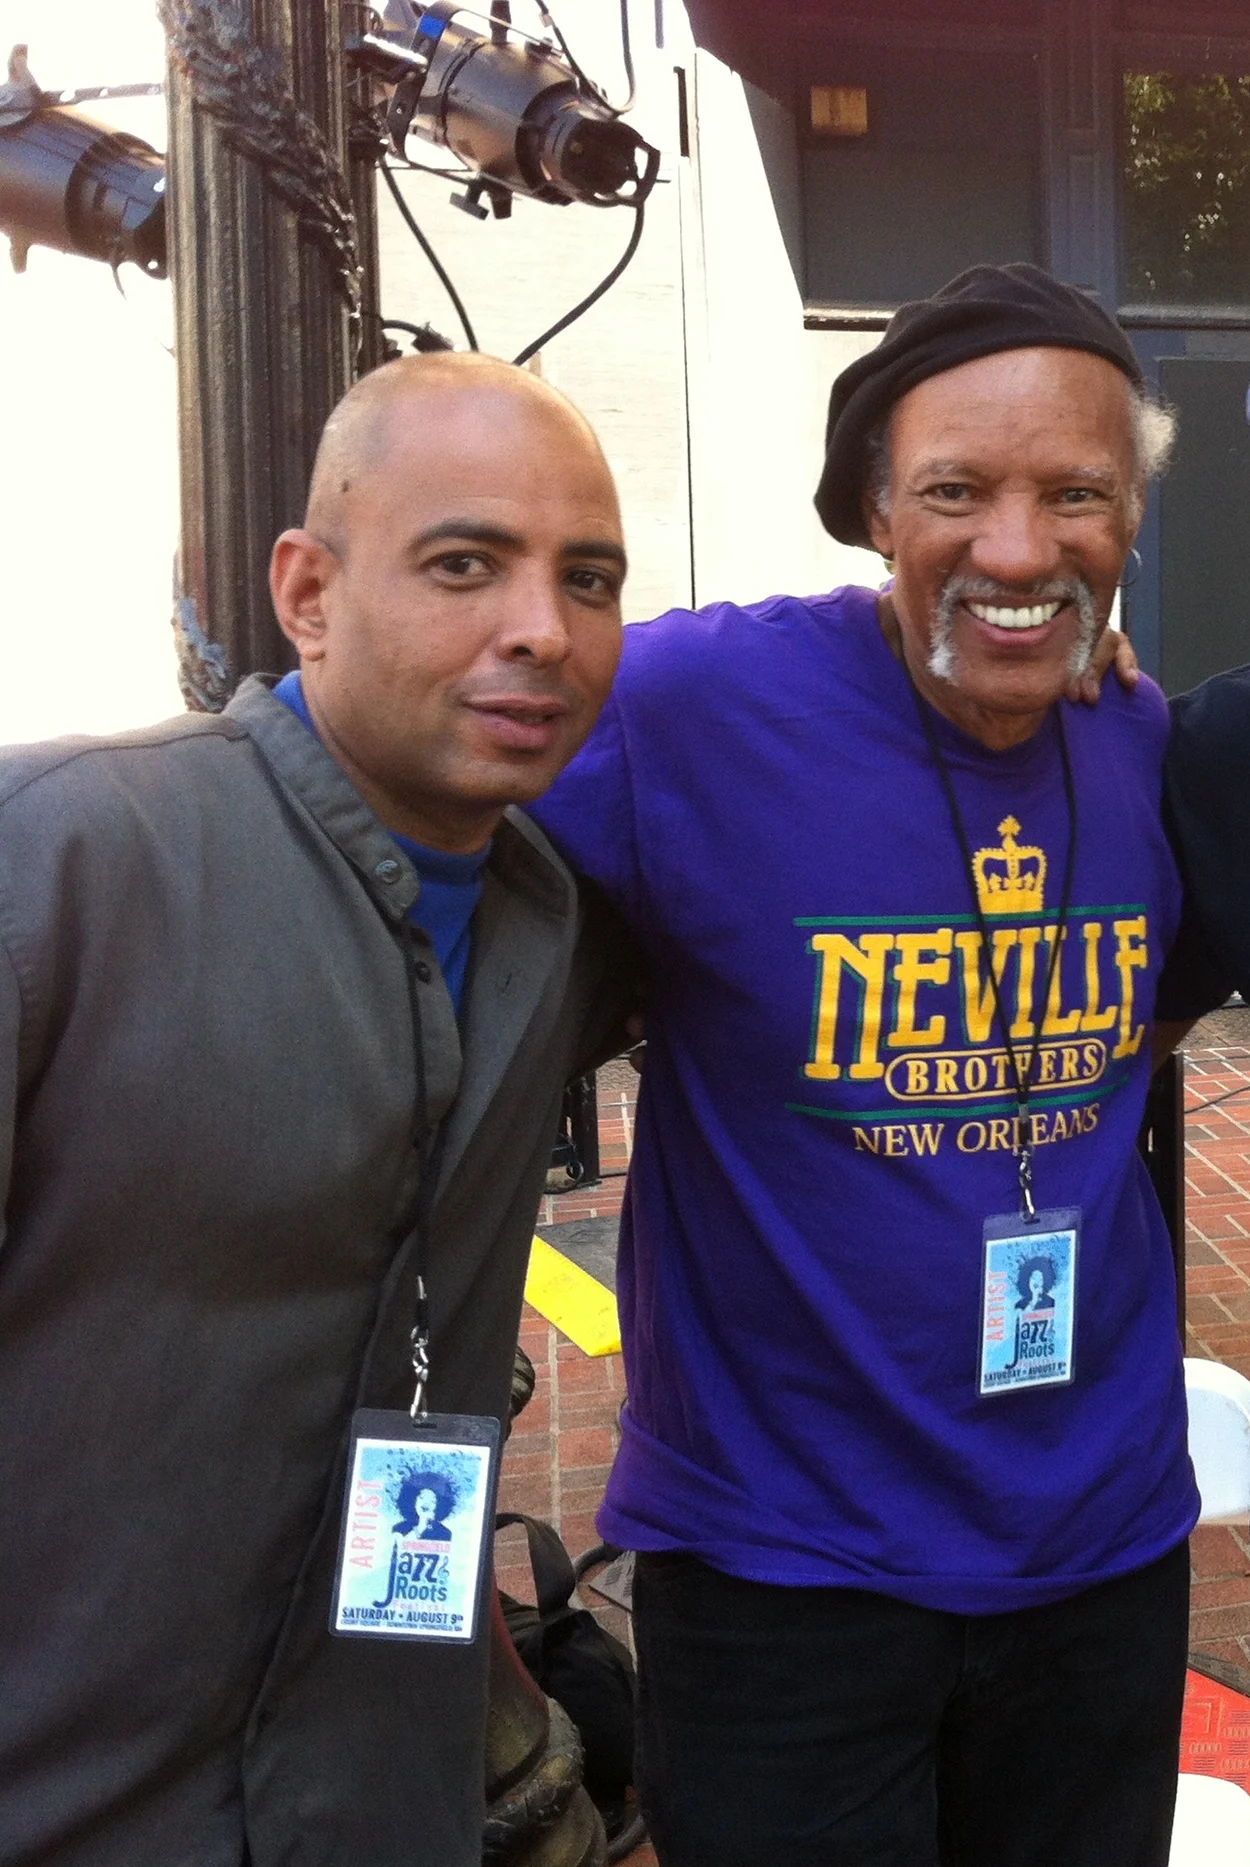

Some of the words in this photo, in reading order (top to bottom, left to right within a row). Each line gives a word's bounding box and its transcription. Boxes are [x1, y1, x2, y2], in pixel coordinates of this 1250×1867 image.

[801, 915, 1149, 1080] NEVILLE
[853, 1123, 944, 1156] NEW
[986, 1271, 1007, 1342] ARTIST
[1019, 1342, 1055, 1360] Roots
[350, 1480, 383, 1569] ARTIST
[395, 1576, 448, 1602] Roots
[342, 1607, 395, 1621] SATURDAY
[406, 1611, 448, 1624] AUGUST
